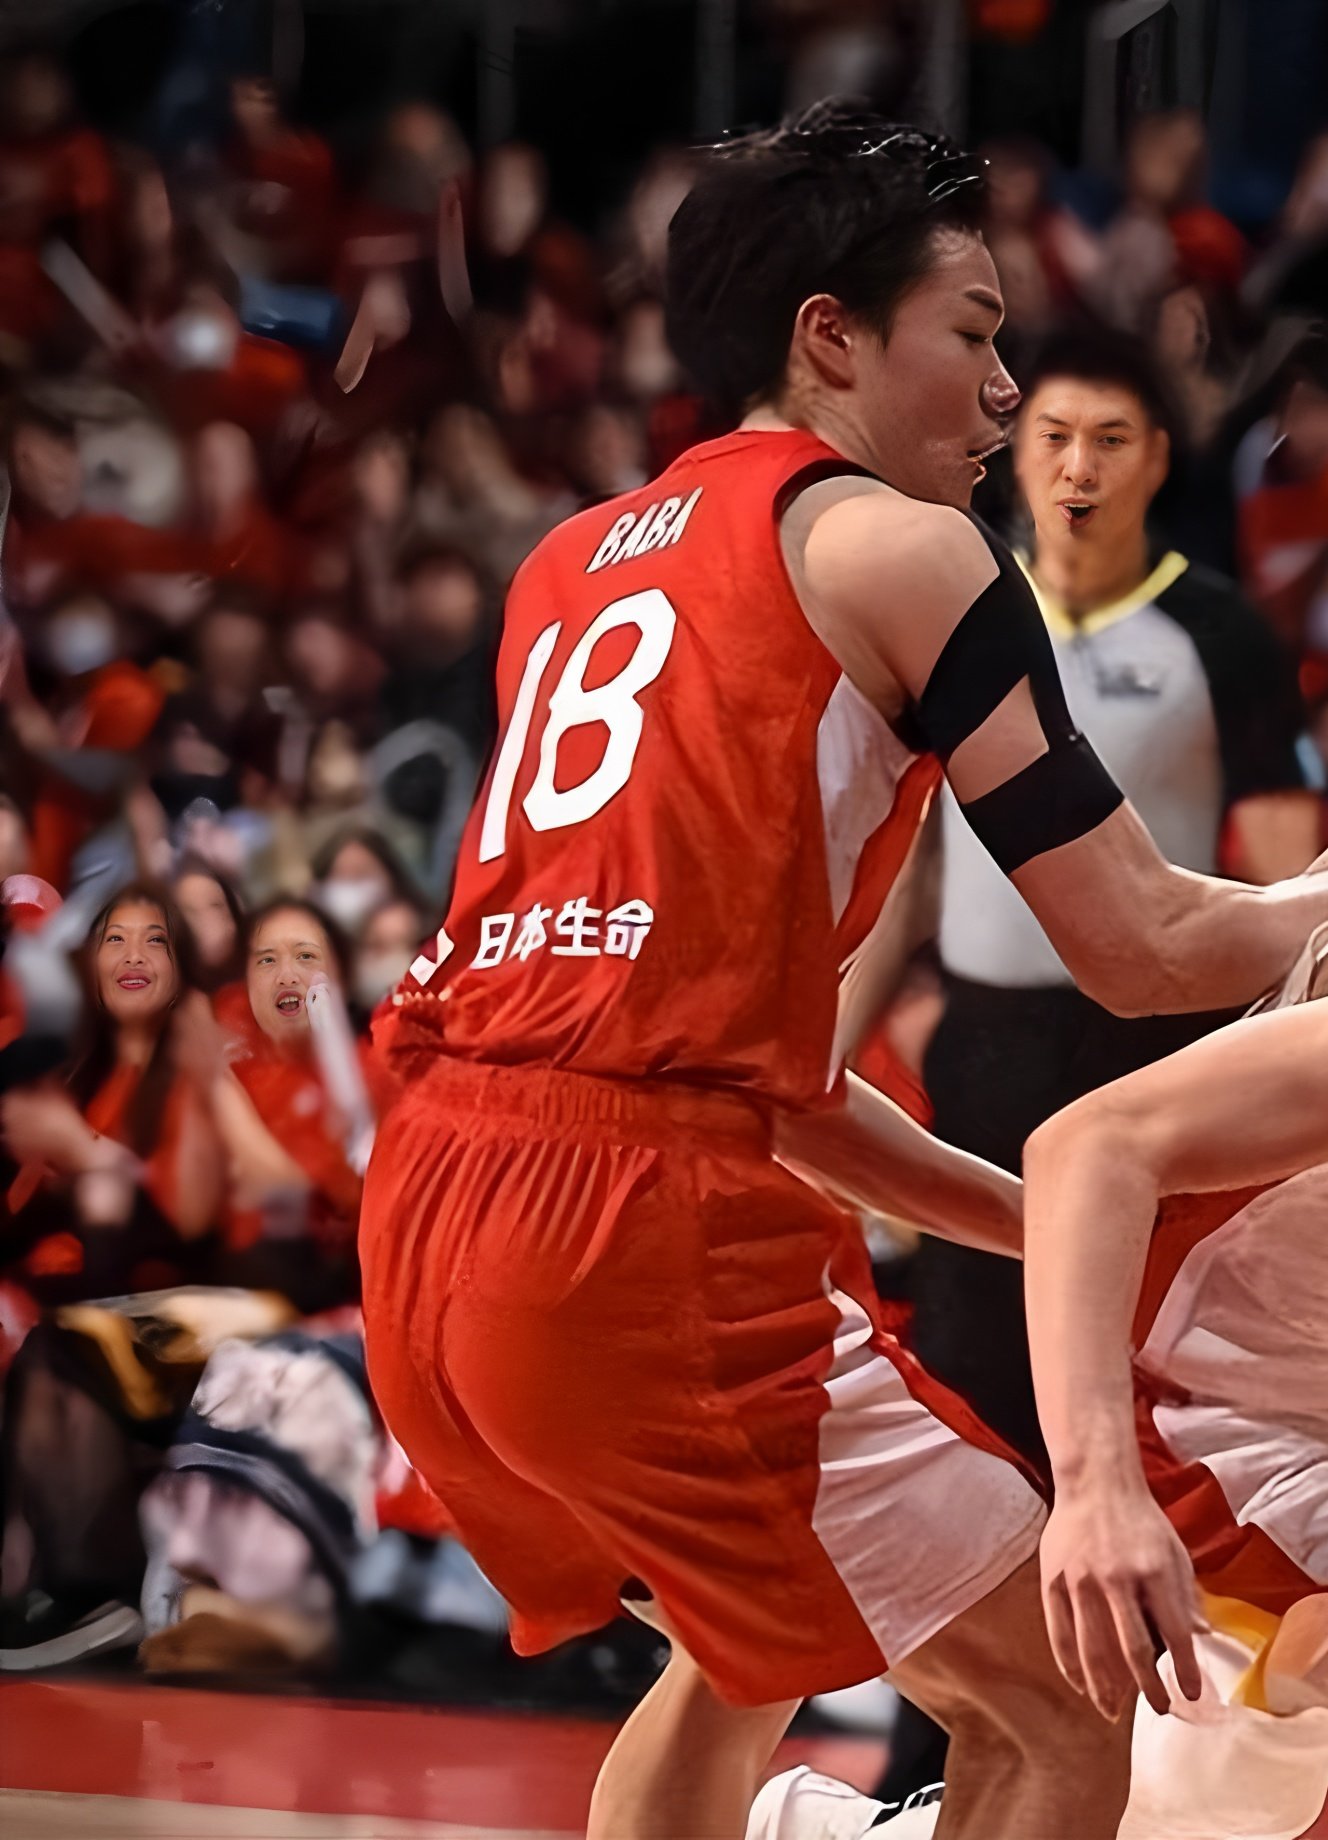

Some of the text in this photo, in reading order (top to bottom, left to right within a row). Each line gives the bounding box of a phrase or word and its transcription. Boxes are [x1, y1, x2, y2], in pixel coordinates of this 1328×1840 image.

[586, 486, 703, 573] BABA
[478, 588, 677, 863] 18
[469, 896, 655, 970] 日本生命
